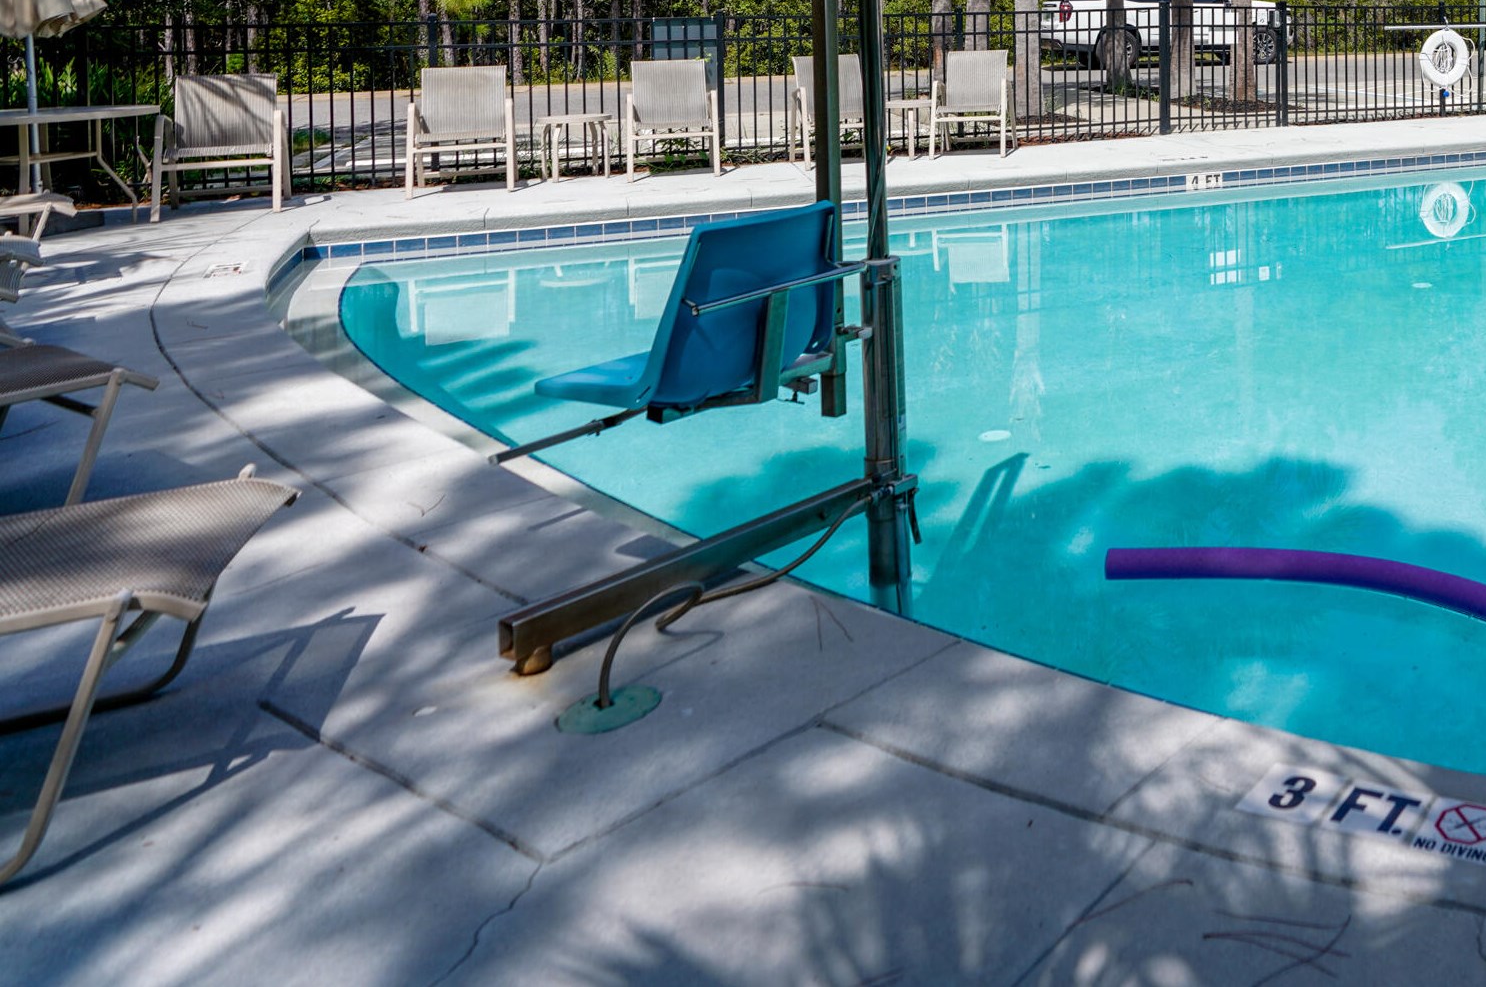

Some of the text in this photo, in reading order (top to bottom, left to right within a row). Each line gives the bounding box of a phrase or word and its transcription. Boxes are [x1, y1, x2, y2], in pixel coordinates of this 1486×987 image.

[1267, 776, 1423, 835] 3 FT.
[1413, 837, 1437, 851] NO
